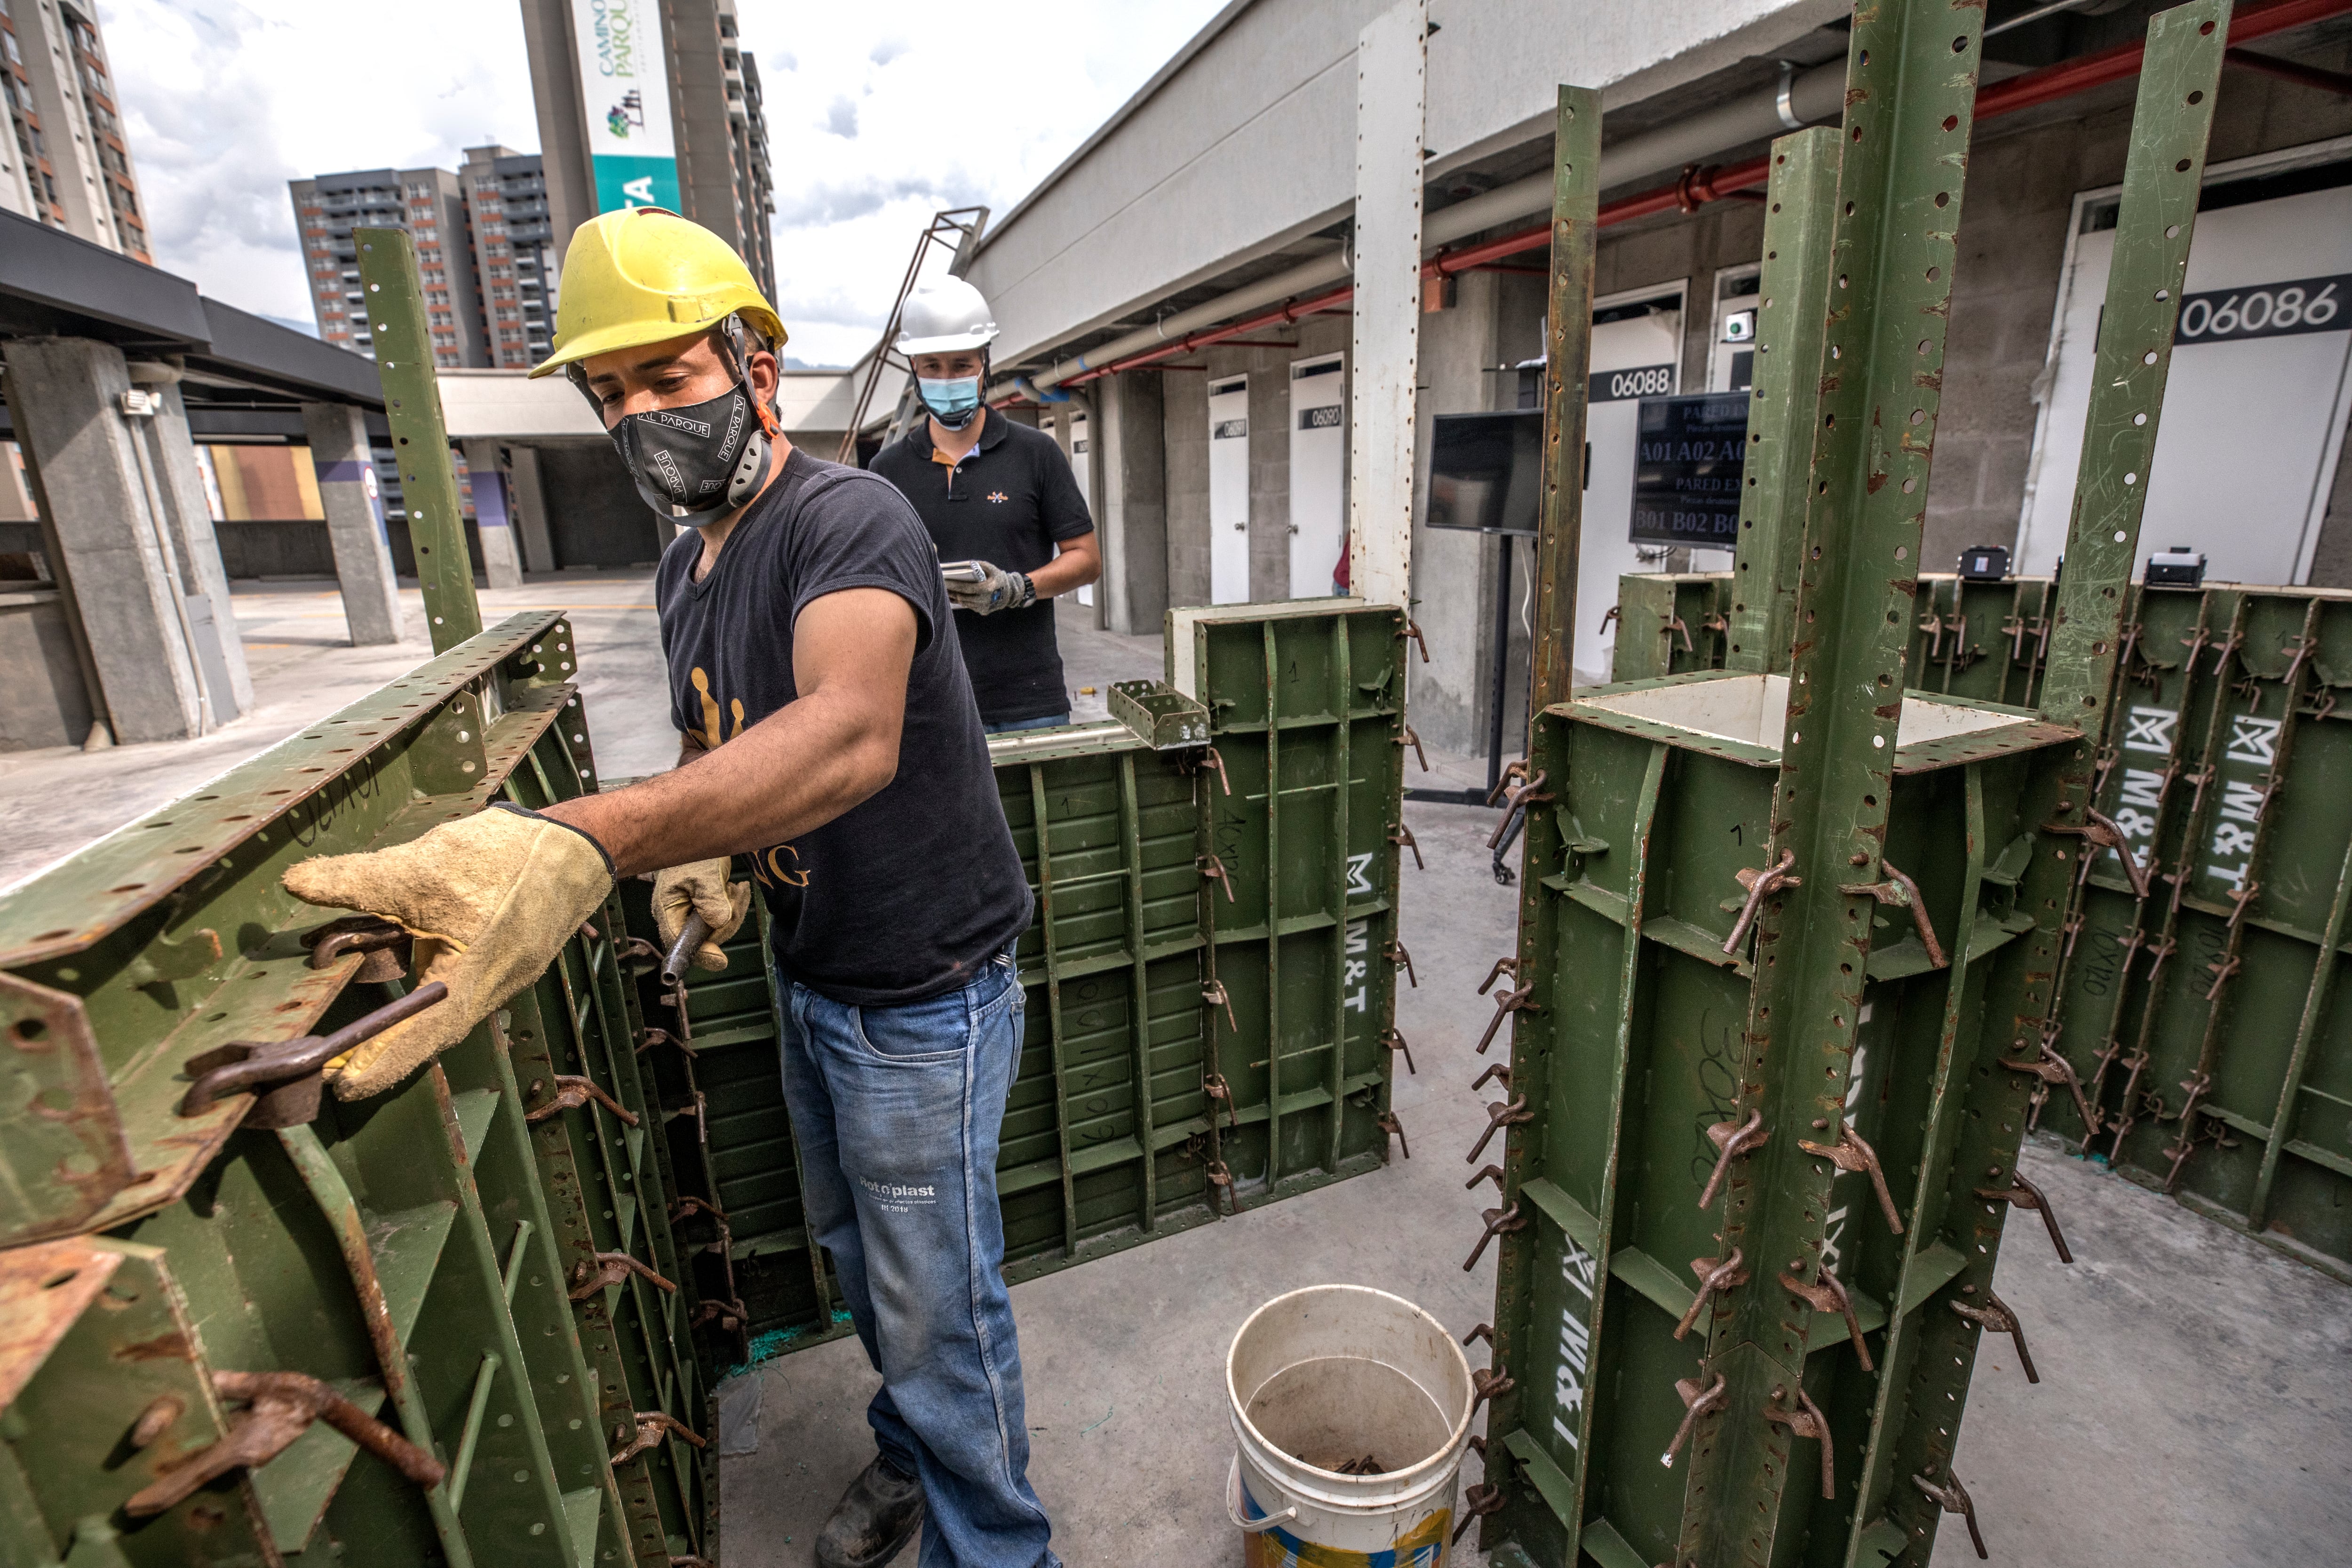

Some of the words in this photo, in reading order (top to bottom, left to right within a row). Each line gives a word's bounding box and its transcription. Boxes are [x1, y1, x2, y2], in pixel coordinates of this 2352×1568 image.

[590, 0, 614, 77] CAMINO
[2180, 282, 2338, 337] 06086
[1611, 368, 1669, 398] 06088
[735, 397, 744, 411] AL
[1312, 407, 1339, 427] 06090
[640, 411, 656, 422] AL
[661, 414, 708, 435] PARQUE
[720, 416, 741, 460] PARQUE
[1641, 442, 1671, 461] A01
[1677, 441, 1715, 461] A02
[1719, 440, 1746, 461] A0
[658, 454, 683, 493] PARQUE
[1672, 511, 1708, 532] B02
[2208, 780, 2265, 891] M&T
[1344, 921, 1368, 1012] M&T
